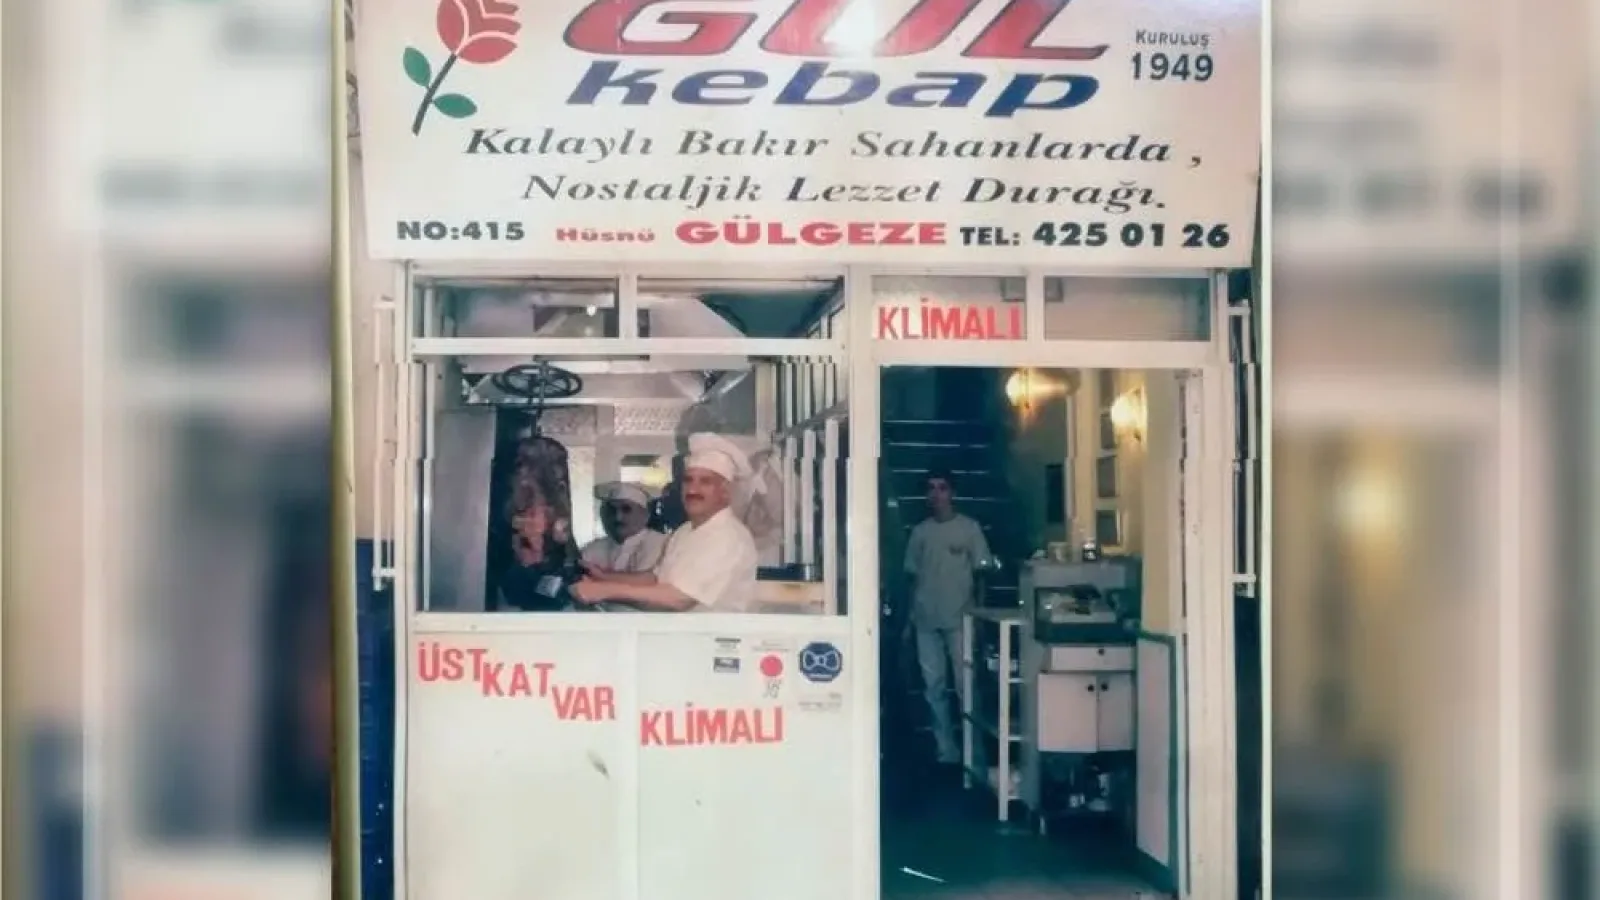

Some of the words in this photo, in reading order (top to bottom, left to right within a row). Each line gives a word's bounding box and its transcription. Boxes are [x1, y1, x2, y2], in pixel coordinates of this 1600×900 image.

[1130, 53, 1214, 82] 1949
[566, 60, 1100, 118] kebap
[463, 128, 653, 163] Kalaylı
[678, 129, 829, 157] Bakır
[521, 174, 762, 209] Nostaljik
[786, 178, 941, 203] Lezzet
[964, 178, 1166, 213] Durağı.
[396, 220, 525, 241] NO:415
[556, 226, 655, 242] Hüsnü
[676, 215, 947, 246] GÜLGEZE
[960, 226, 1020, 247] TEL:
[1032, 222, 1108, 247] 425
[1120, 223, 1164, 248] 01
[1182, 223, 1231, 249] 26
[878, 297, 1023, 340] KLİMALI
[418, 643, 487, 682] ÜST
[481, 662, 555, 697] KAT
[552, 686, 616, 720] VAR
[640, 702, 783, 746] KLİMALI
